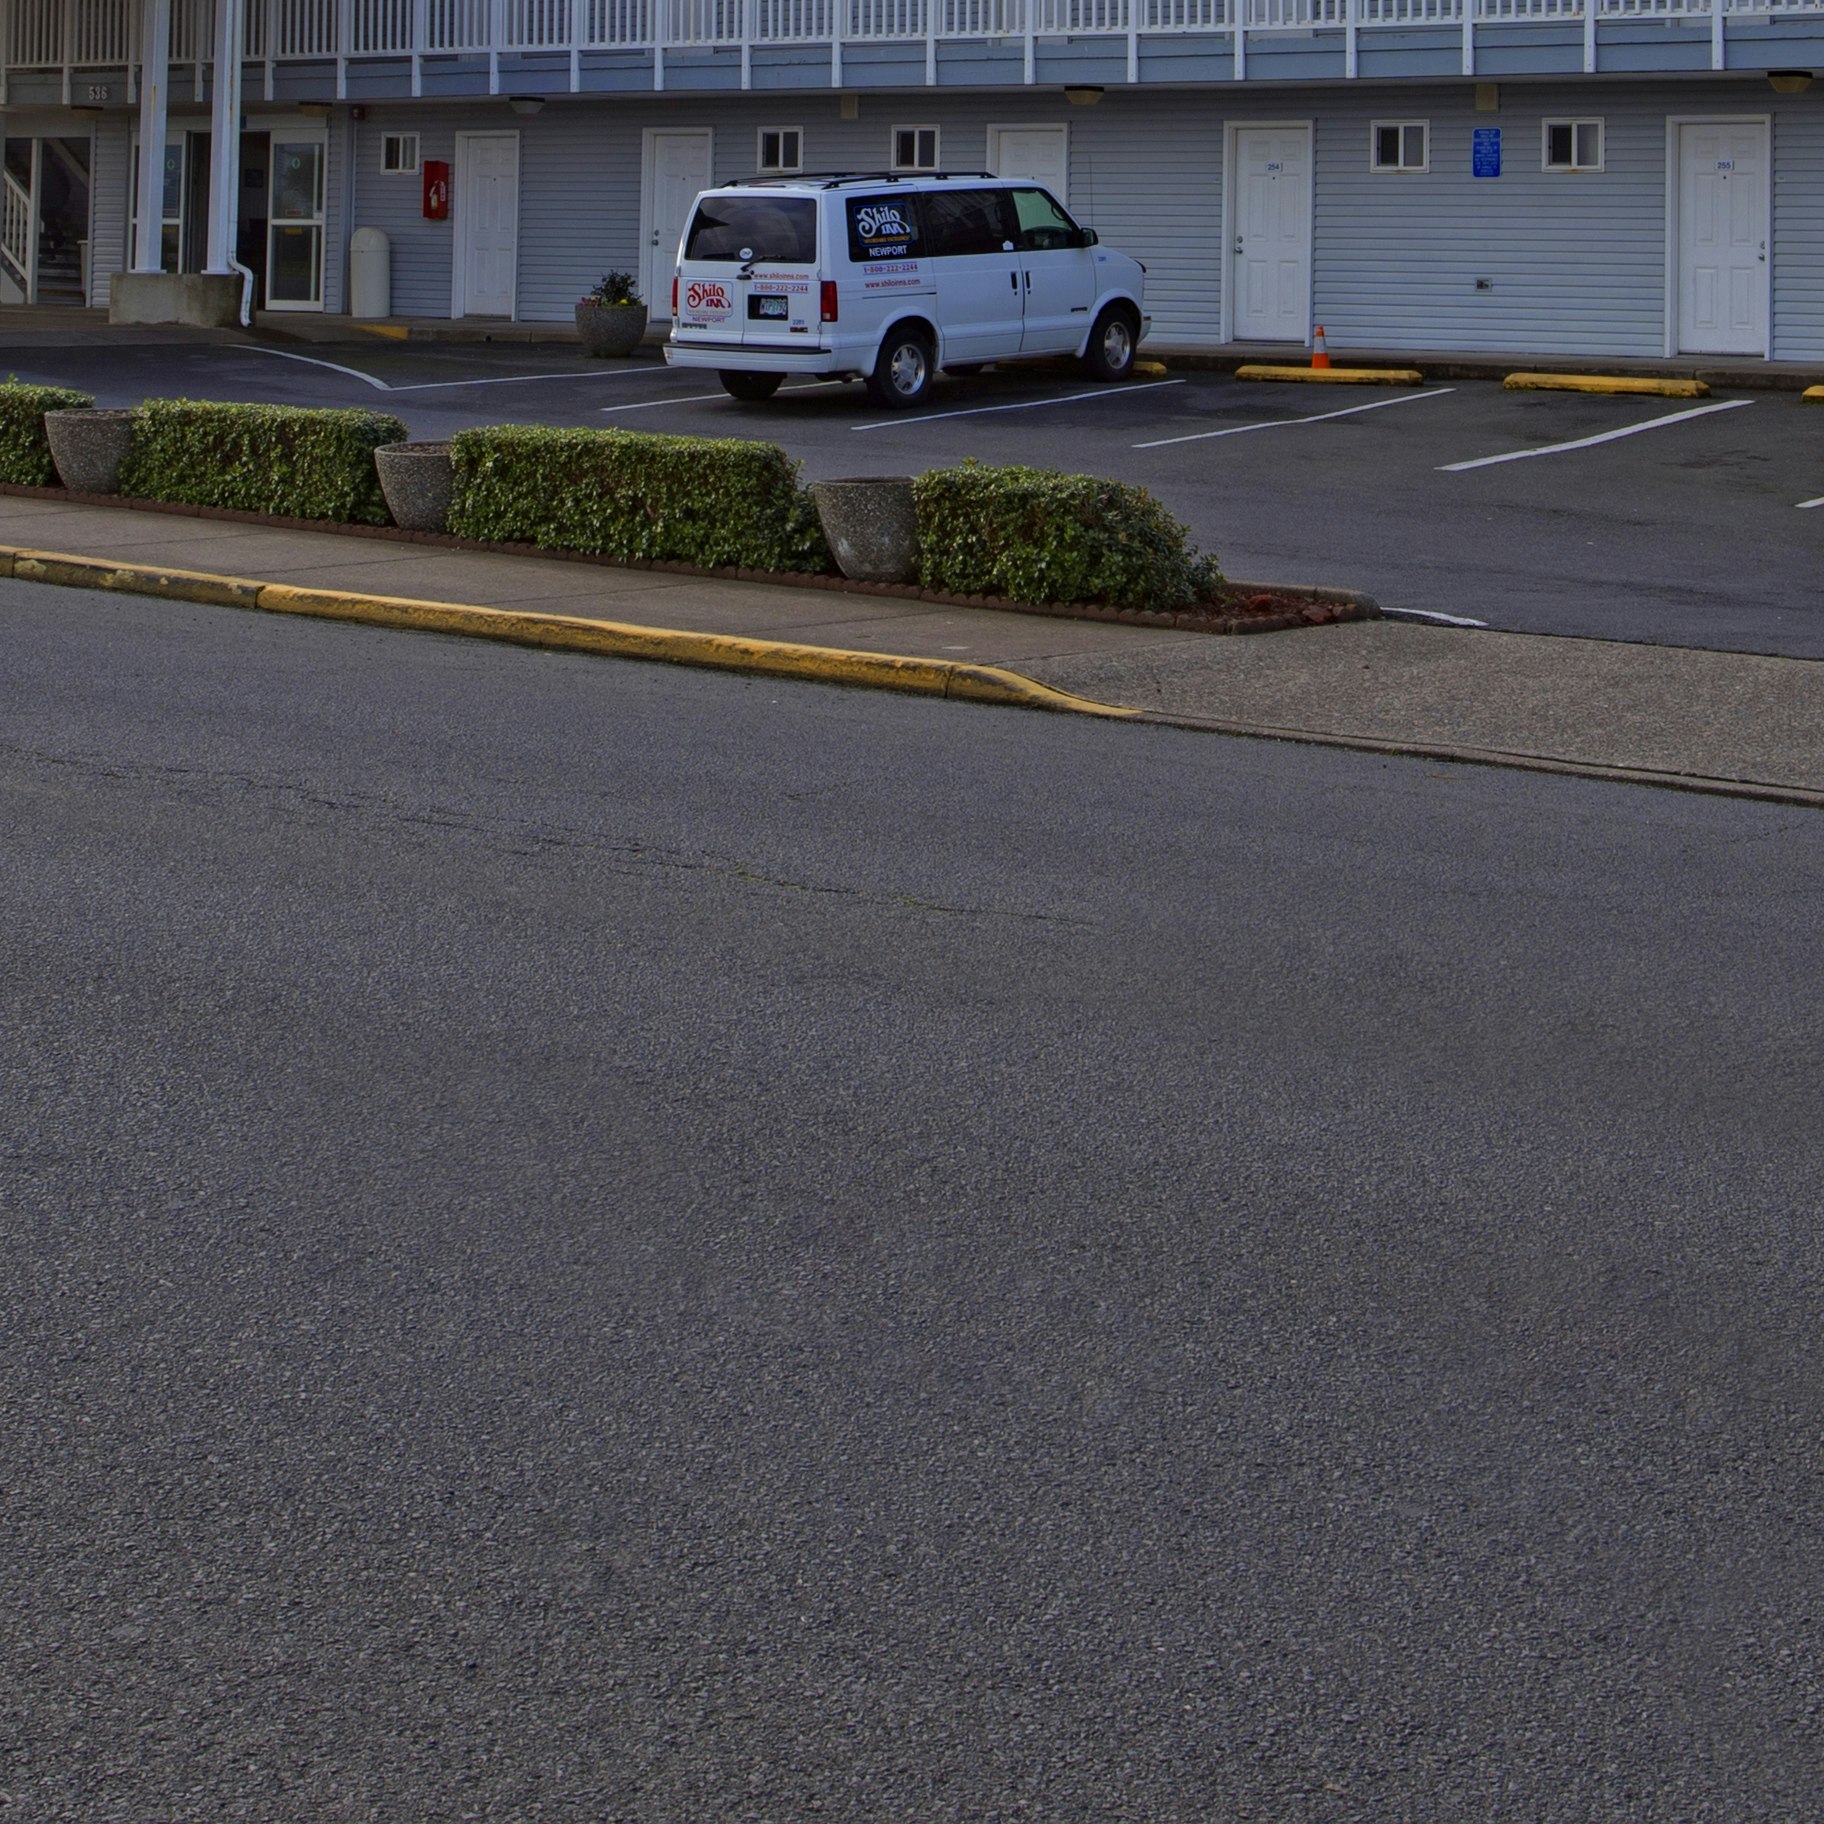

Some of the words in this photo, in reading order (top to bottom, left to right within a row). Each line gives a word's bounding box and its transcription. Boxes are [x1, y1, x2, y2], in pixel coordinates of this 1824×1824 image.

[88, 86, 108, 100] 536
[857, 206, 911, 238] Shilo
[868, 245, 908, 257] NEWPORT
[687, 283, 732, 309] Shilo
